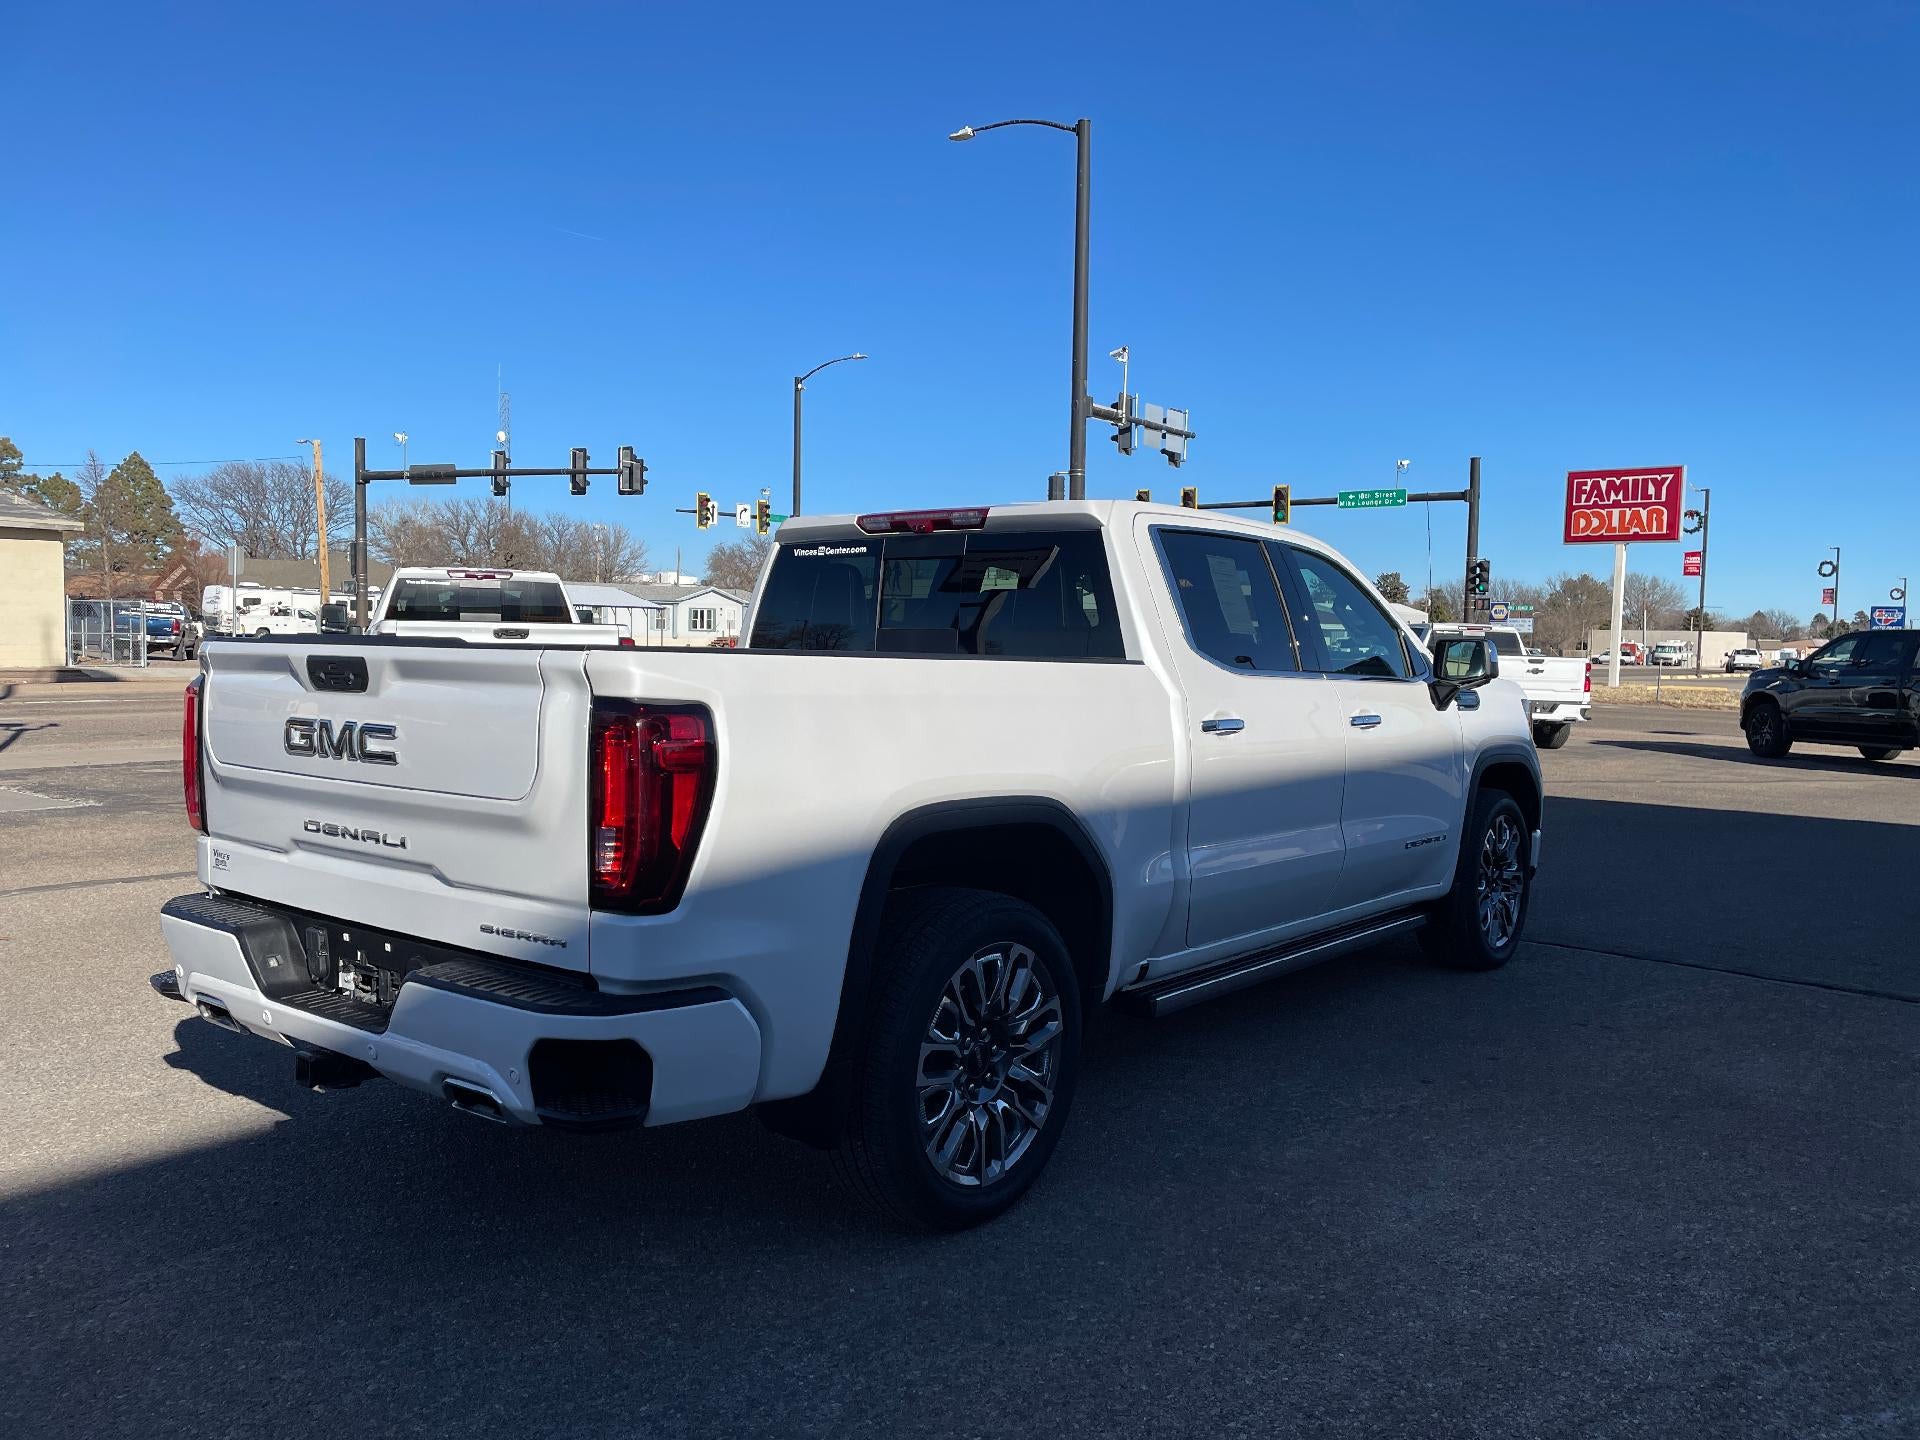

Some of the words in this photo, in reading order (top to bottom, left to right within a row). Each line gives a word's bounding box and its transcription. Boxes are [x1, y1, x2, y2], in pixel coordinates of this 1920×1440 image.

[1375, 491, 1397, 499] Street
[1573, 474, 1674, 505] FAMILY
[1571, 506, 1667, 536] DOLLAR
[284, 716, 400, 766] GMC
[303, 820, 408, 849] DENALI
[480, 924, 567, 948] SIERRA
